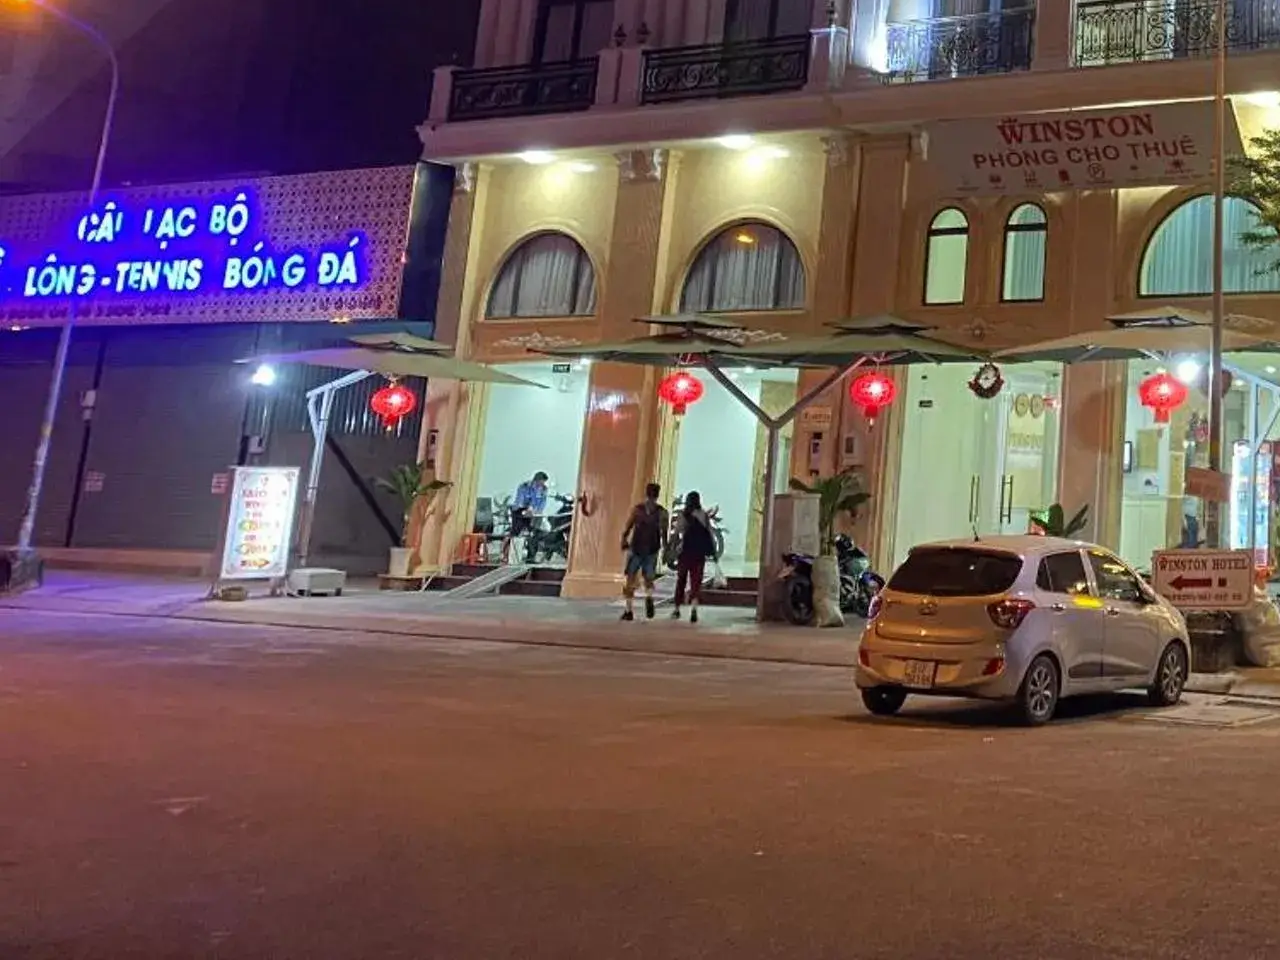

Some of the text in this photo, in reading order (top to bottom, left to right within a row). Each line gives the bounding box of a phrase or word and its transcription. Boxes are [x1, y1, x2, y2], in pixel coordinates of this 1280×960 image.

[998, 114, 1154, 144] WINSTON
[973, 135, 1198, 169] PHÒNG CHO THUÊ
[209, 193, 248, 246] BỘ
[318, 236, 359, 285] ĐÁ
[1158, 557, 1248, 571] WINSTON HOTEL
